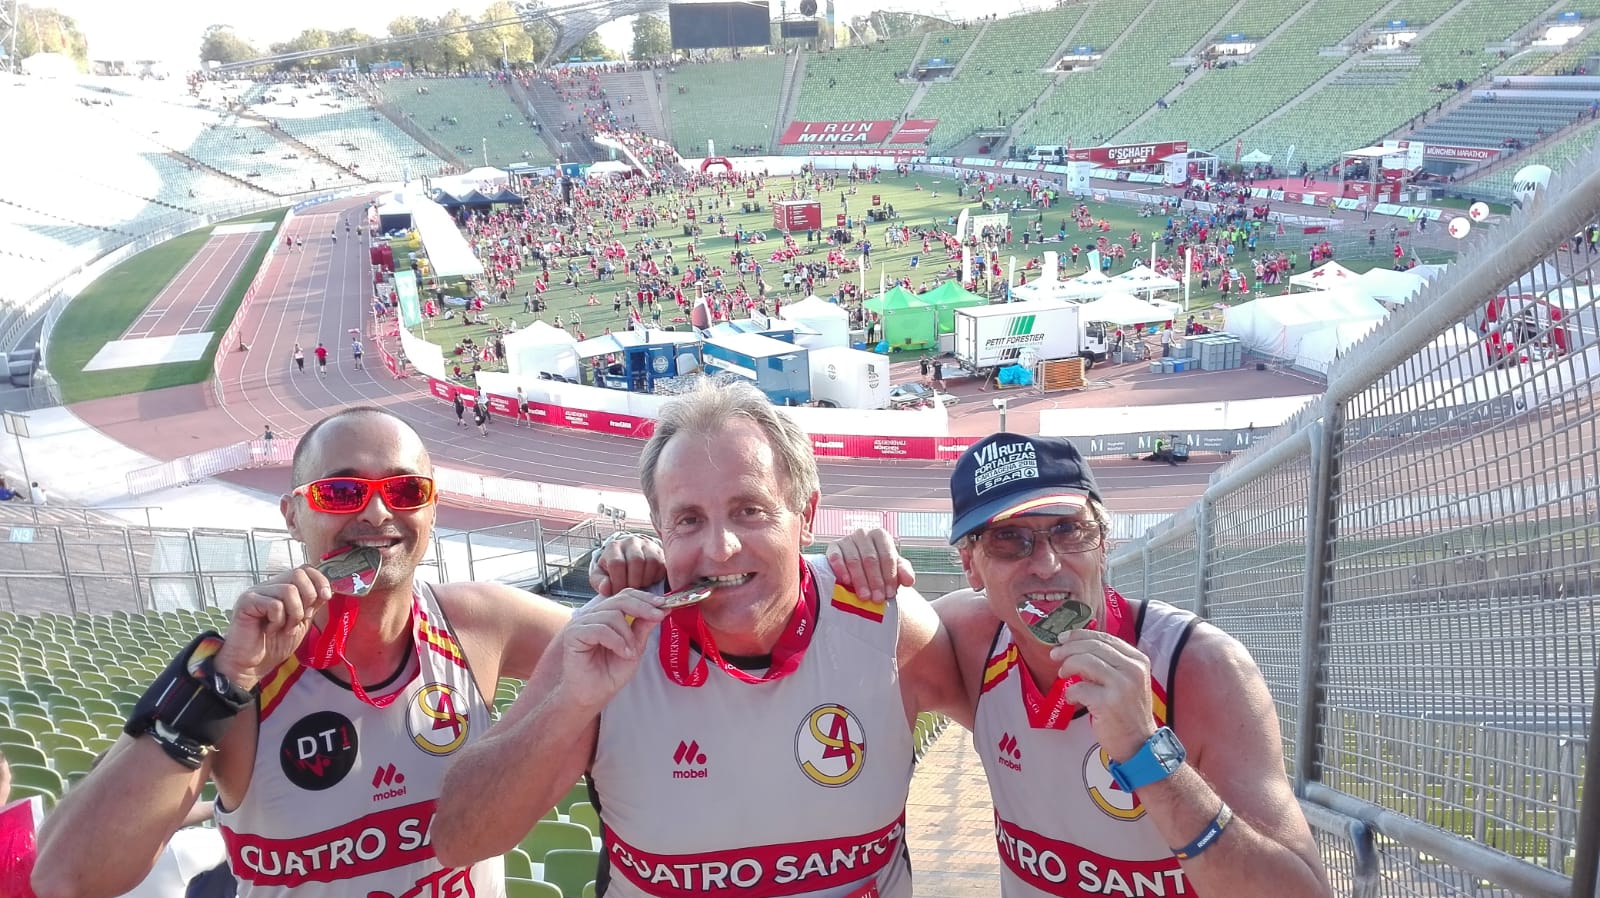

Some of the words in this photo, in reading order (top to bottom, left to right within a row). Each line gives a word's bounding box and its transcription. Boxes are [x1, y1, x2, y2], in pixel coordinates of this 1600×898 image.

[824, 123, 874, 132] RUN
[798, 133, 867, 142] MINGA
[1457, 151, 1488, 159] MARATHON
[985, 337, 1006, 347] PETIT
[1006, 333, 1045, 345] FORESTIER
[973, 441, 999, 467] VII
[998, 441, 1036, 457] RUTA
[974, 451, 1037, 477] FORTALEZAS
[985, 471, 1021, 489] SPAR
[999, 756, 1022, 772] mobel
[673, 768, 708, 779] mobel
[373, 786, 407, 802] mobel
[240, 827, 387, 876] CUATRO
[612, 842, 763, 891] CUATRO
[1078, 859, 1188, 898] SANT
